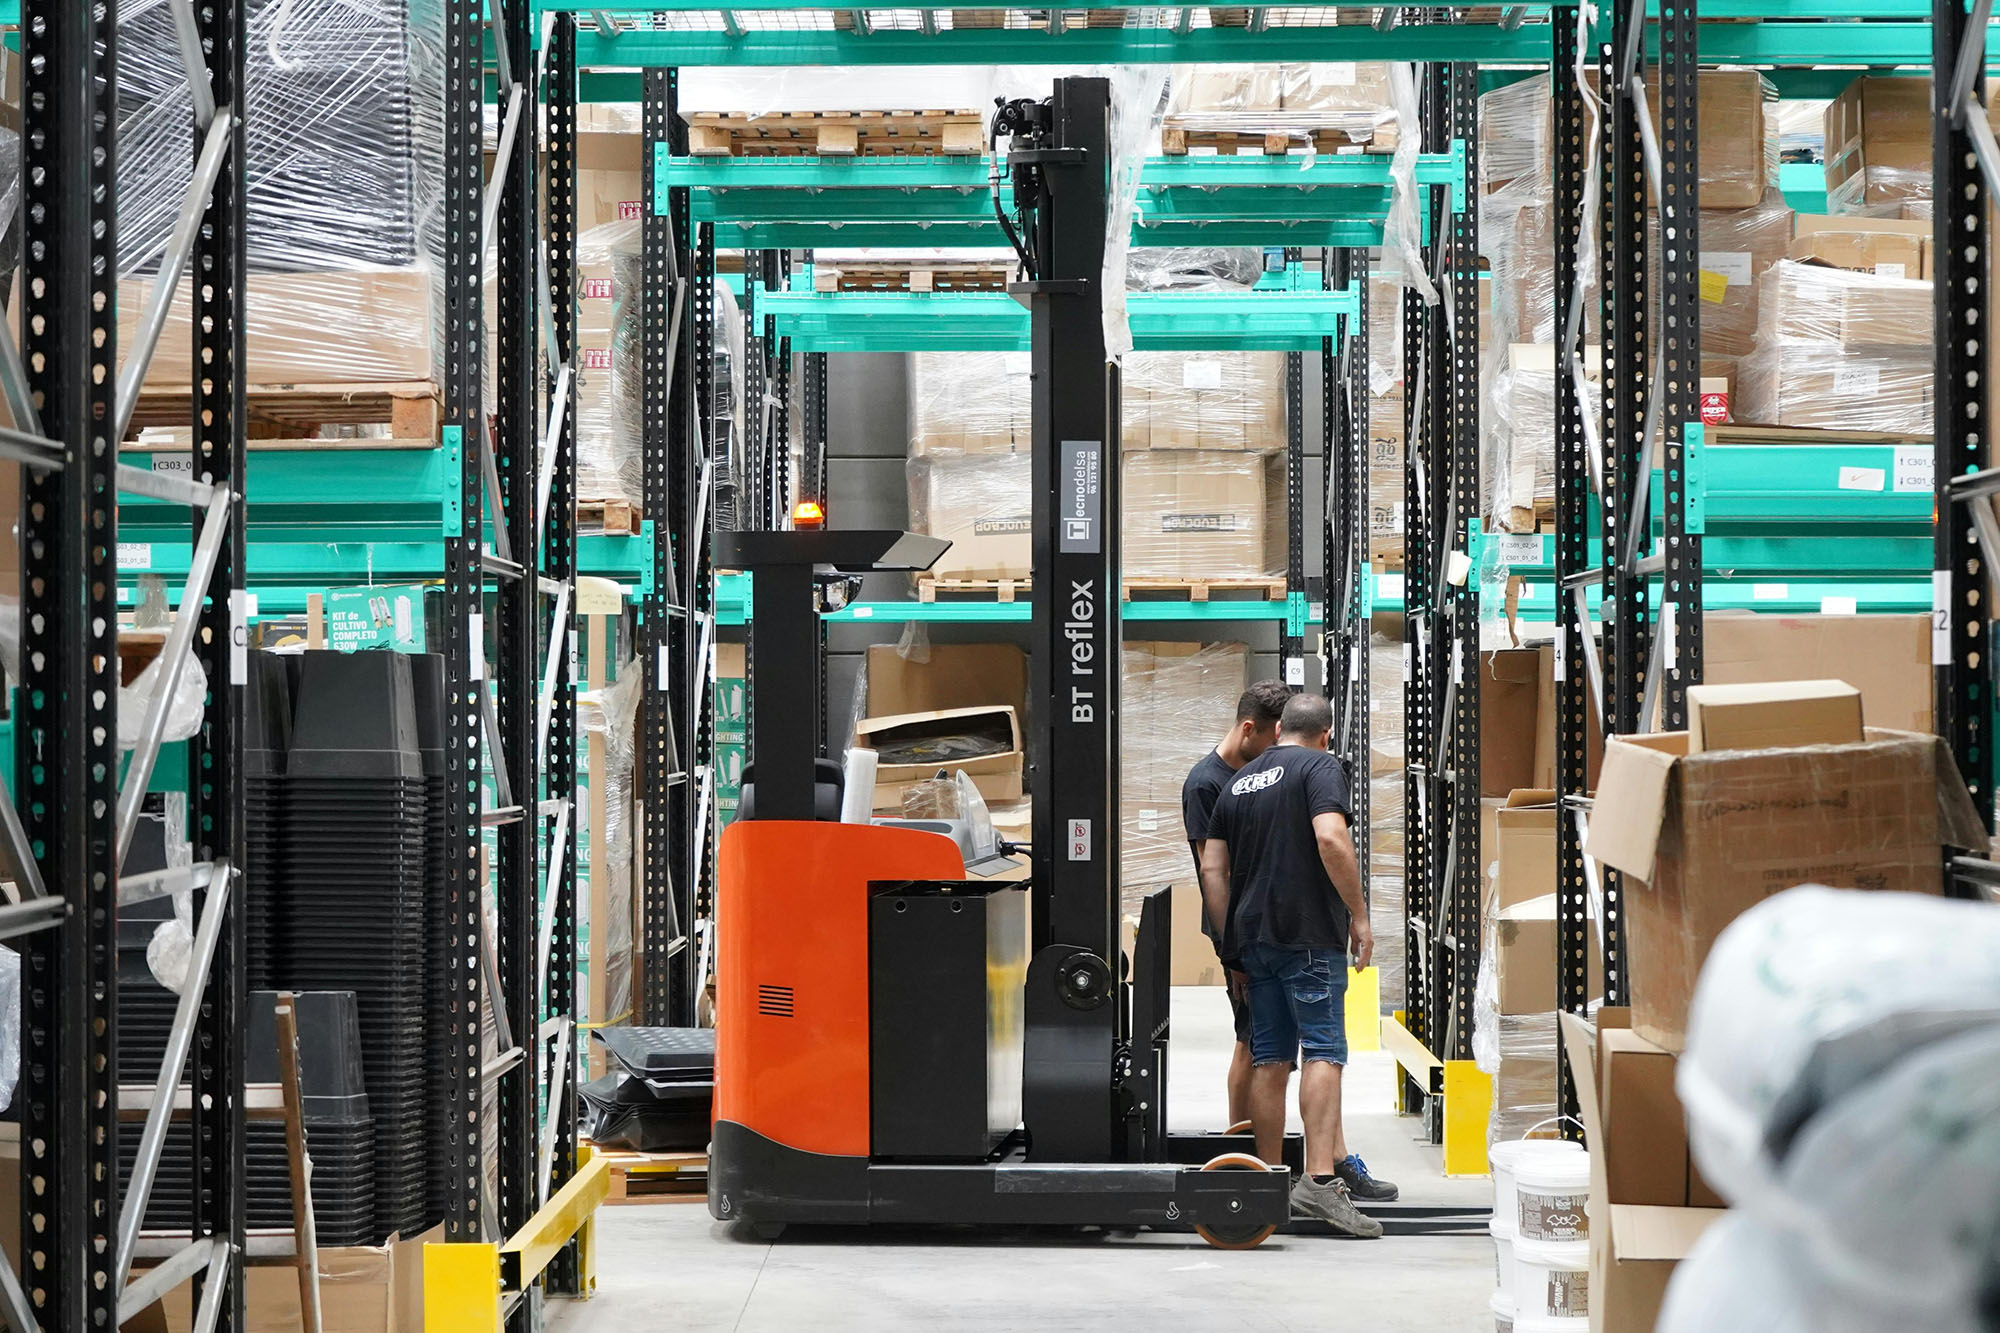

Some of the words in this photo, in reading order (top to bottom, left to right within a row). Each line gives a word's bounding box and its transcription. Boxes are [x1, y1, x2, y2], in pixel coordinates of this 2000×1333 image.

[333, 611, 347, 621] KIT
[348, 611, 359, 620] de
[333, 621, 367, 631] CULTIVO
[1065, 580, 1094, 674] reflex
[333, 630, 377, 640] COMPLETO
[333, 641, 358, 650] 630W
[1291, 667, 1300, 675] C9
[1072, 686, 1094, 722] BT
